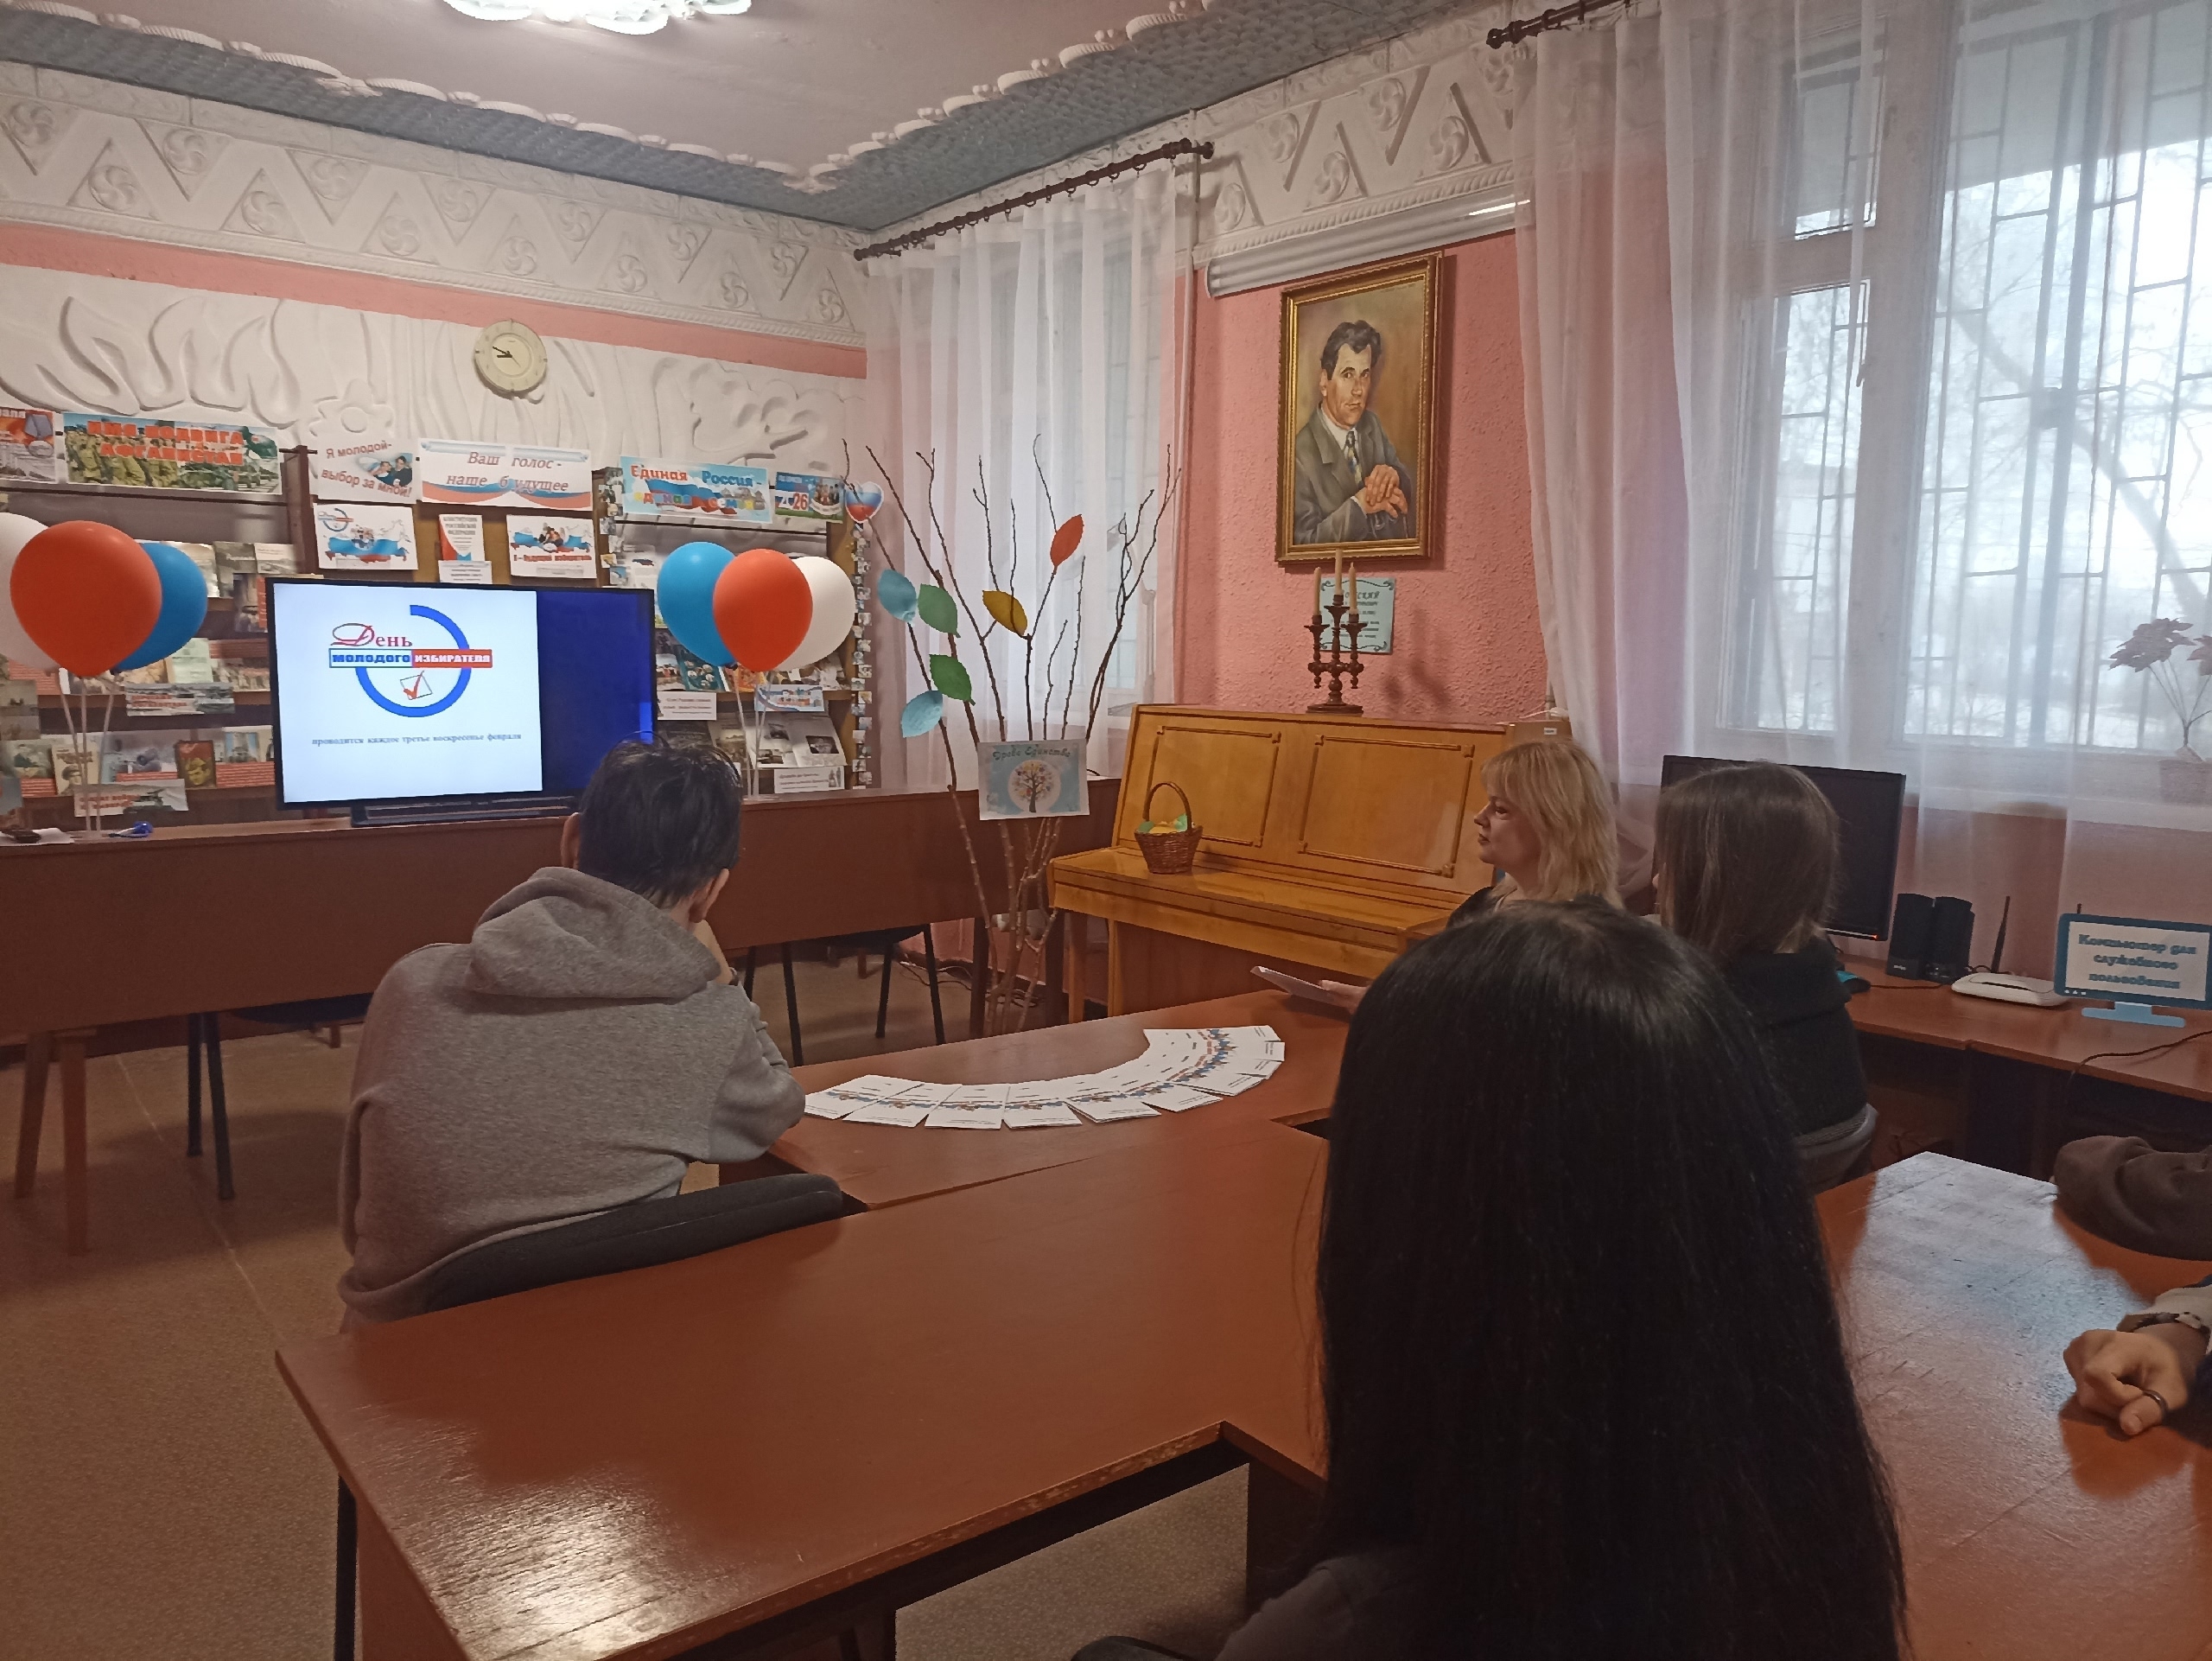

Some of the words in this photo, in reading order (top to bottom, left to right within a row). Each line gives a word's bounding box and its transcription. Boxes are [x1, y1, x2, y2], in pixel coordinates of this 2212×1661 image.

[326, 449, 335, 459] Я
[467, 451, 500, 466] Ваш
[512, 457, 554, 468] голос
[321, 469, 360, 487] выбор
[362, 479, 375, 489] за
[378, 483, 412, 497] мной!
[446, 475, 488, 487] наше
[631, 465, 689, 481] Единая
[702, 470, 753, 487] Россия
[330, 622, 413, 647] День
[415, 654, 491, 663] ИЗБИРАТЕЛЯ
[312, 738, 364, 747] проводится
[433, 735, 484, 743] воскресенье
[486, 733, 522, 741] февраля
